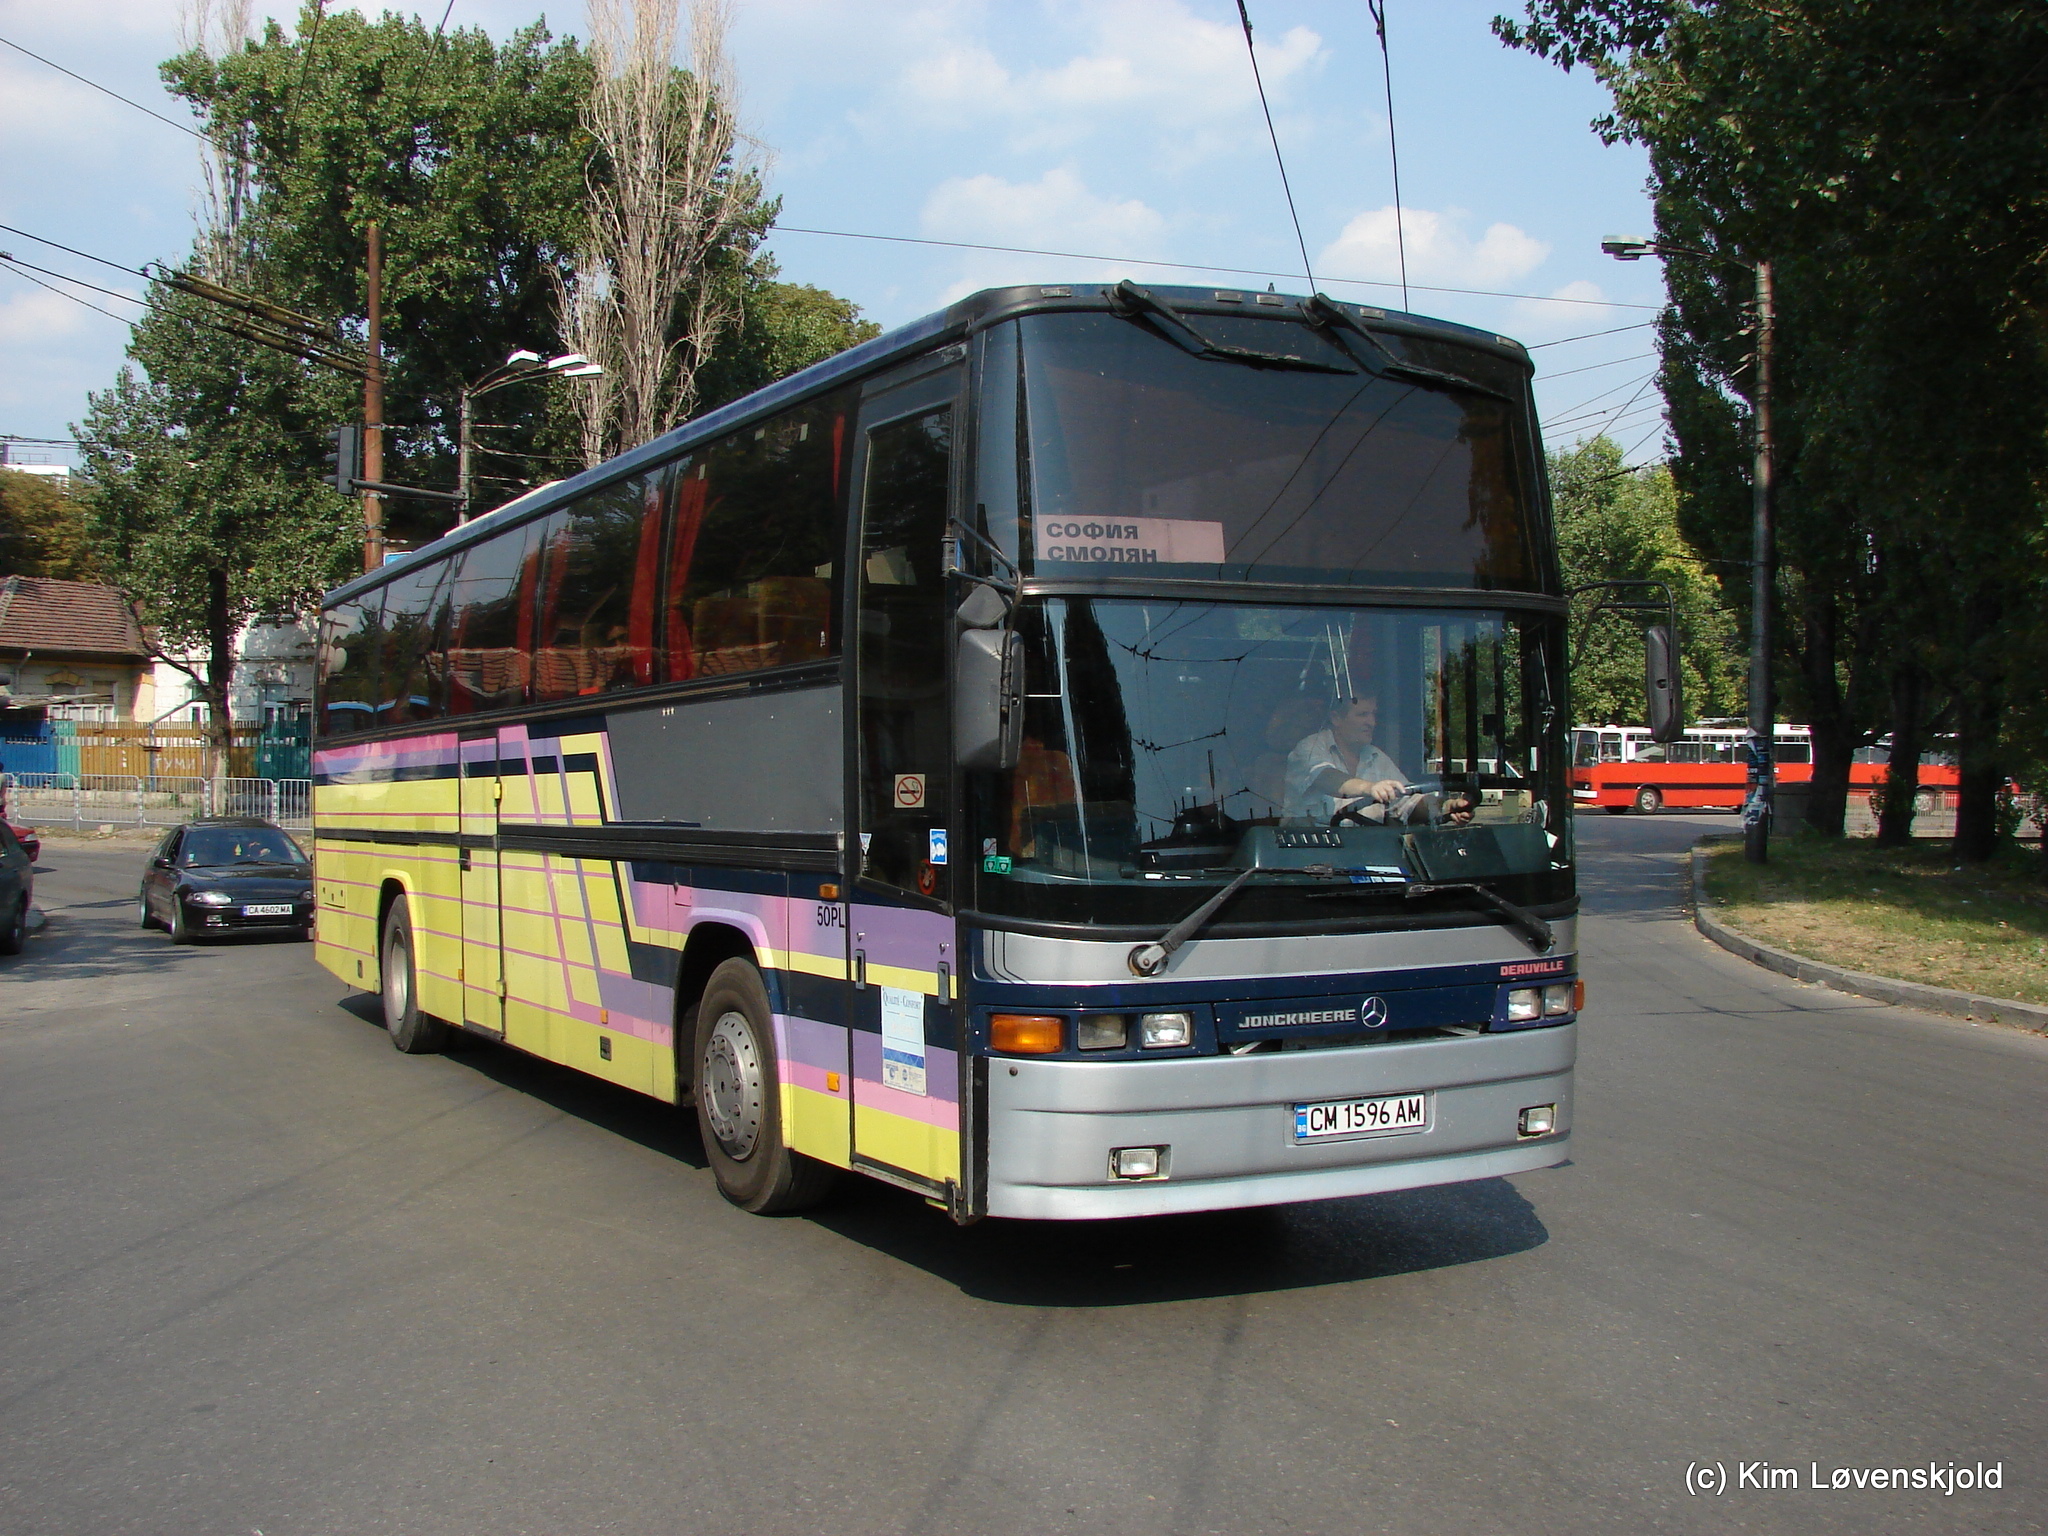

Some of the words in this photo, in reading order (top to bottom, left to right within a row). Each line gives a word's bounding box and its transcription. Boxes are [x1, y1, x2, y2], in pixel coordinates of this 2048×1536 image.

[1046, 522, 1139, 540] СОФИЯ
[1047, 546, 1157, 562] СМОЛЯН
[1500, 960, 1565, 976] DEAUVILLE
[1238, 1009, 1356, 1028] JONCKHEERE
[1310, 1106, 1337, 1131] CM
[1344, 1101, 1390, 1128] 1596
[1395, 1098, 1420, 1123] AM
